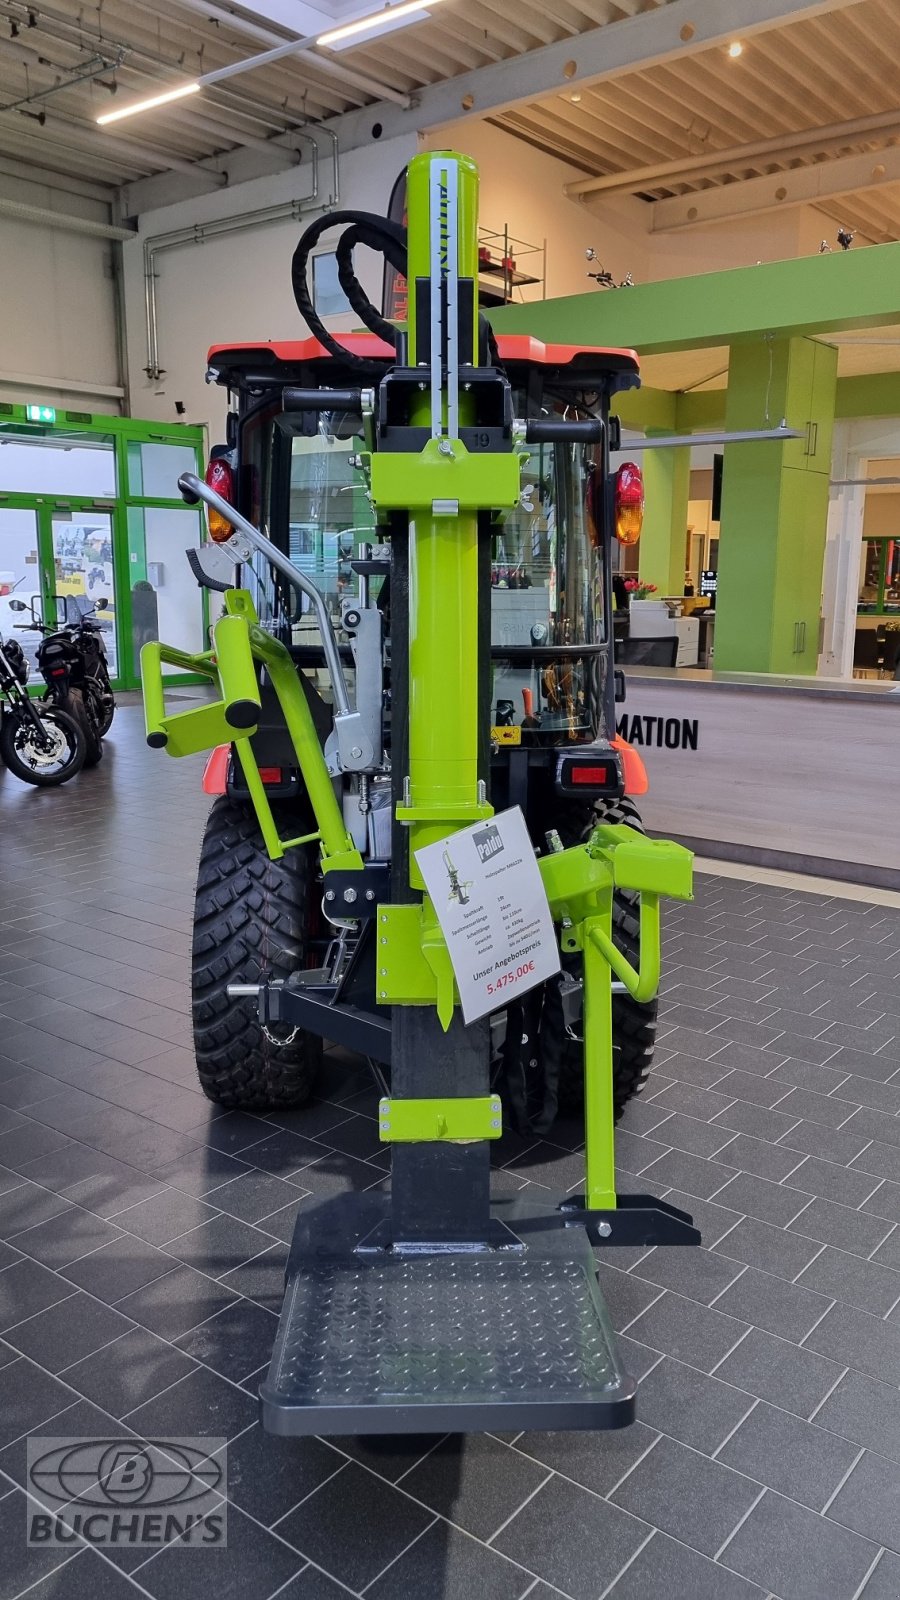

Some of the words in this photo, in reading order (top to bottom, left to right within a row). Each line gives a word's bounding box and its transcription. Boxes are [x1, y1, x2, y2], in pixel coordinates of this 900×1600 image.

[474, 433, 489, 447] 19
[477, 835, 503, 860] Paldu
[473, 964, 494, 981] Unser
[494, 940, 541, 970] Angebotspreis
[486, 960, 536, 995] 5.475,00€
